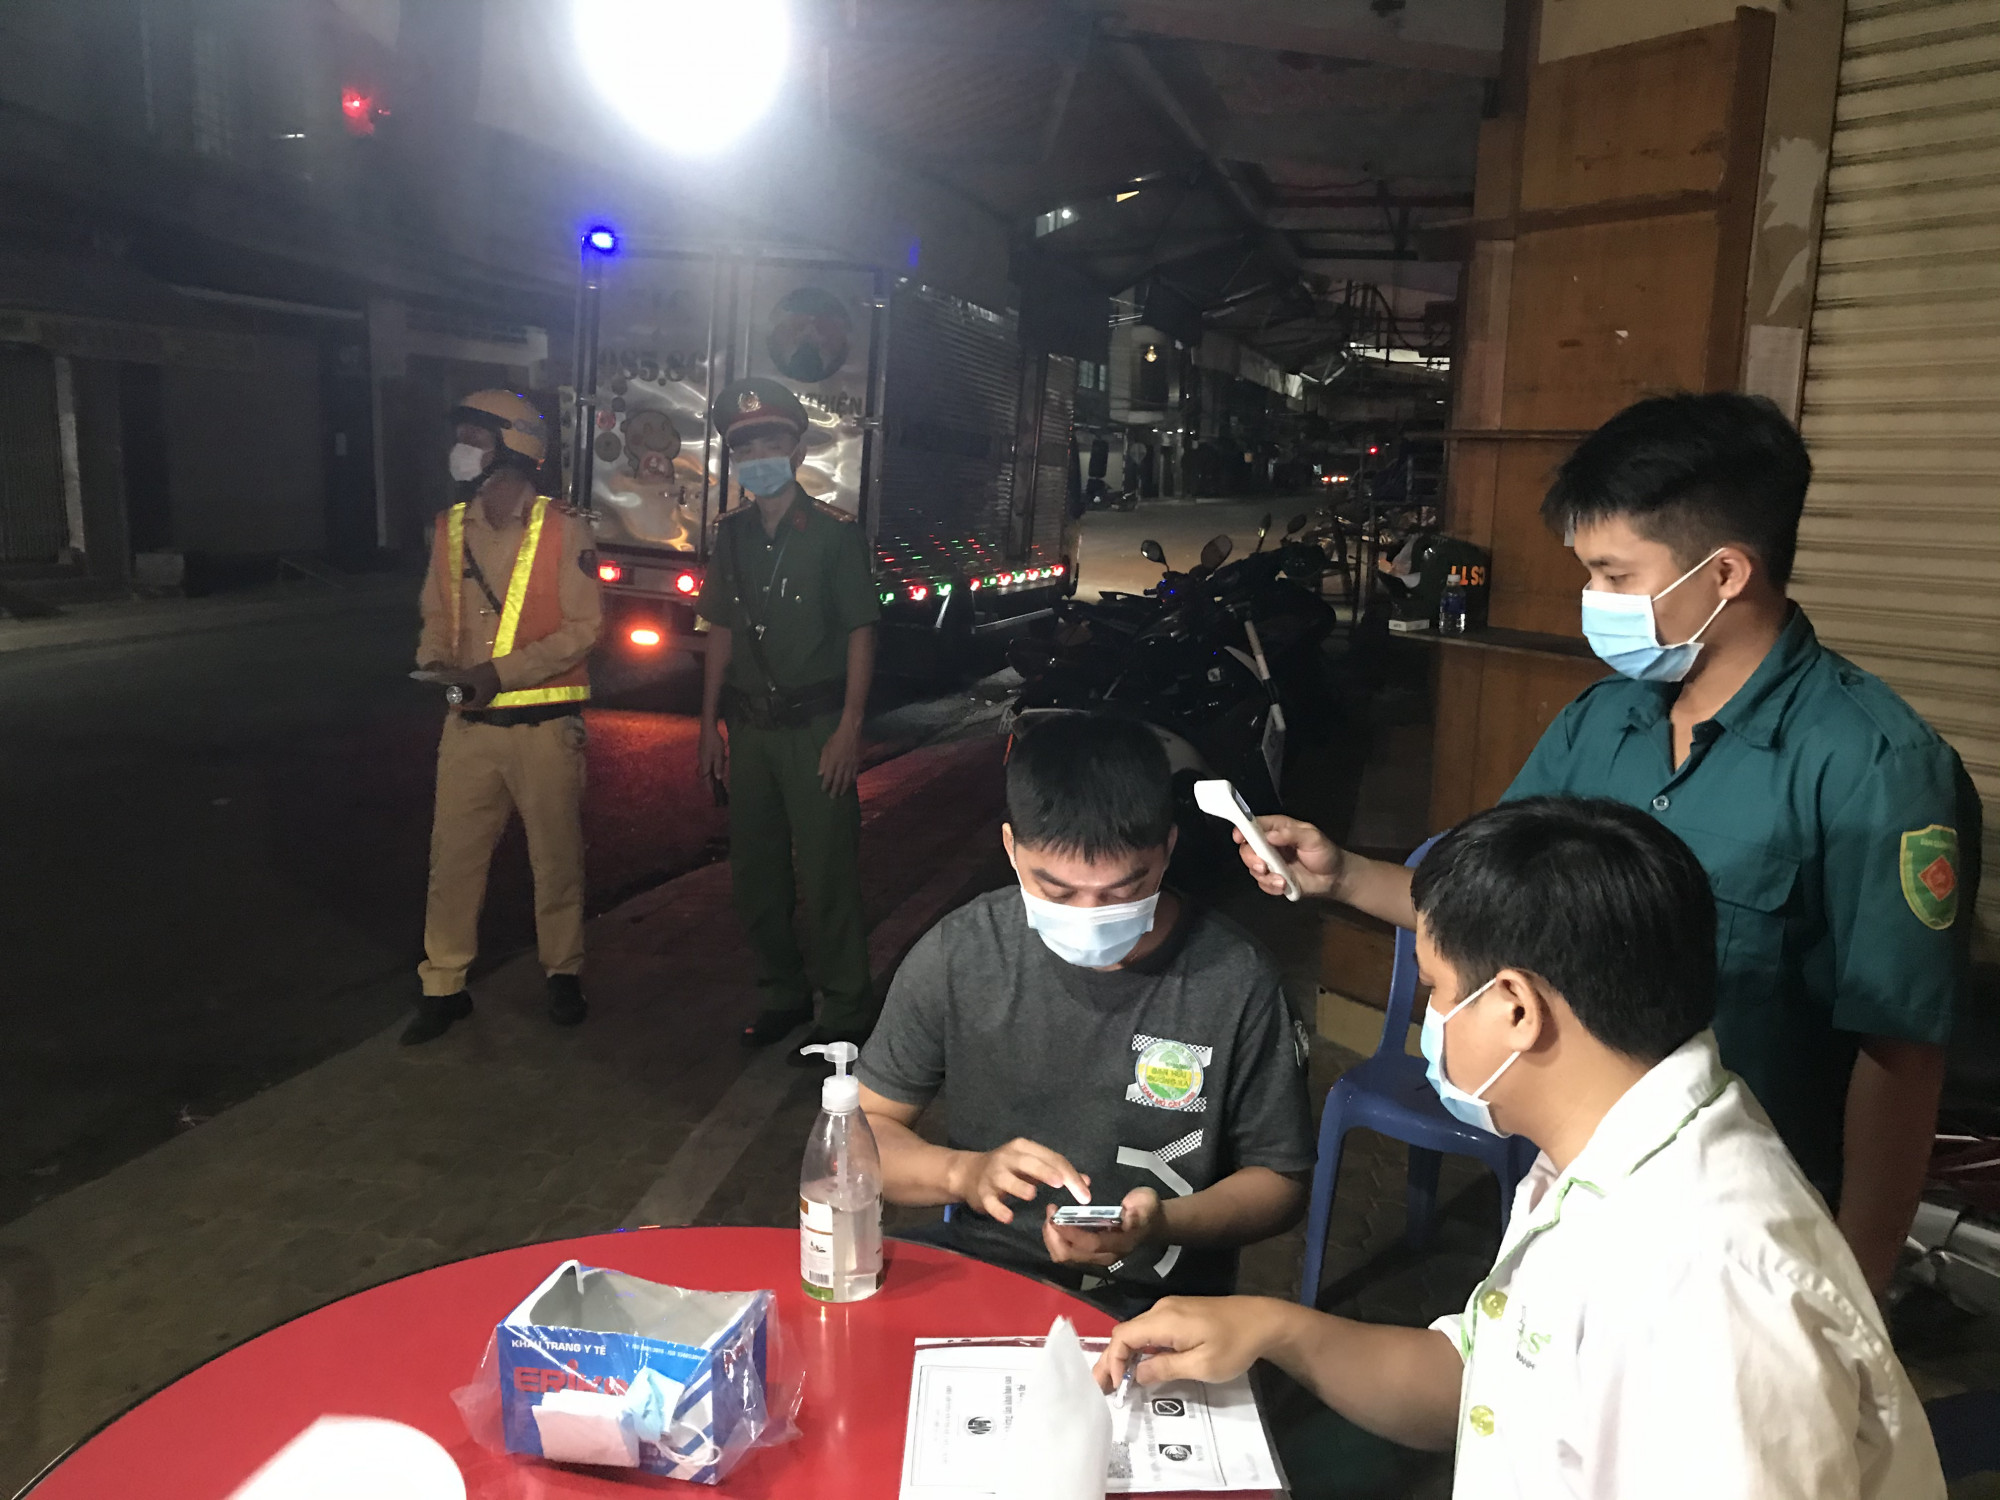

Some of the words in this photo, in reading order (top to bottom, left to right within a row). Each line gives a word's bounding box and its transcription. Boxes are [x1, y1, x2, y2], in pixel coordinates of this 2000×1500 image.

[1141, 1084, 1154, 1100] TEAM
[545, 1340, 581, 1352] TRANG
[584, 1344, 592, 1354] Y
[594, 1344, 607, 1356] TẾ
